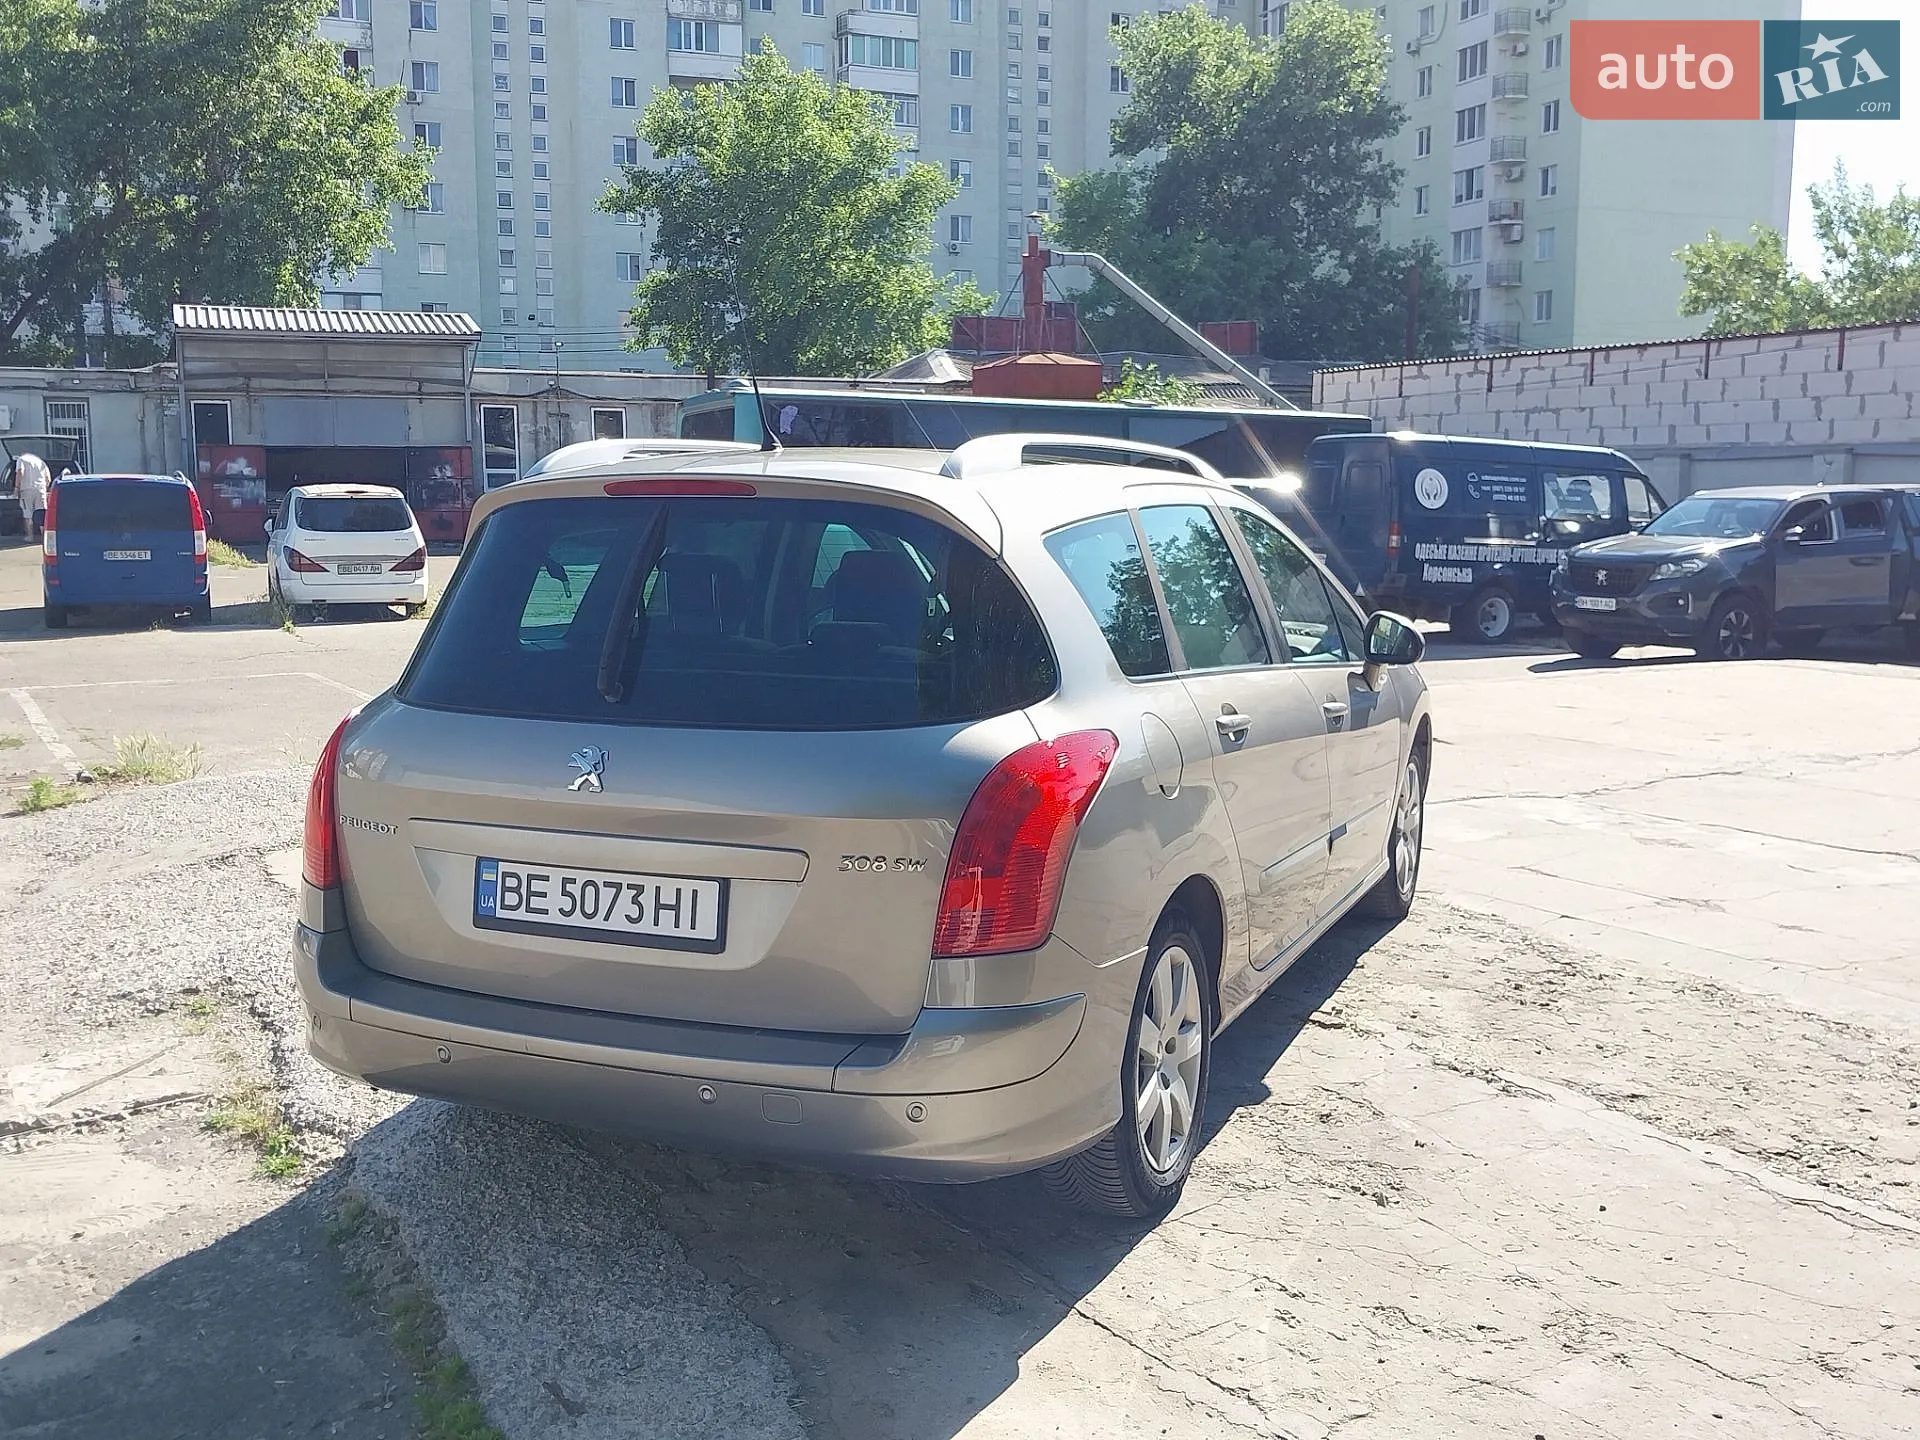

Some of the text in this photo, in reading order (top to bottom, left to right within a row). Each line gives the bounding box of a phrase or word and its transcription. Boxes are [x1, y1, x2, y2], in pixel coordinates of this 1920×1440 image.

[108, 551, 119, 559] BE
[137, 551, 148, 559] ET
[339, 814, 398, 835] PEUGEOT
[836, 854, 928, 872] 308 SW
[480, 894, 495, 909] UA
[500, 871, 699, 931] BE 5073 HI
